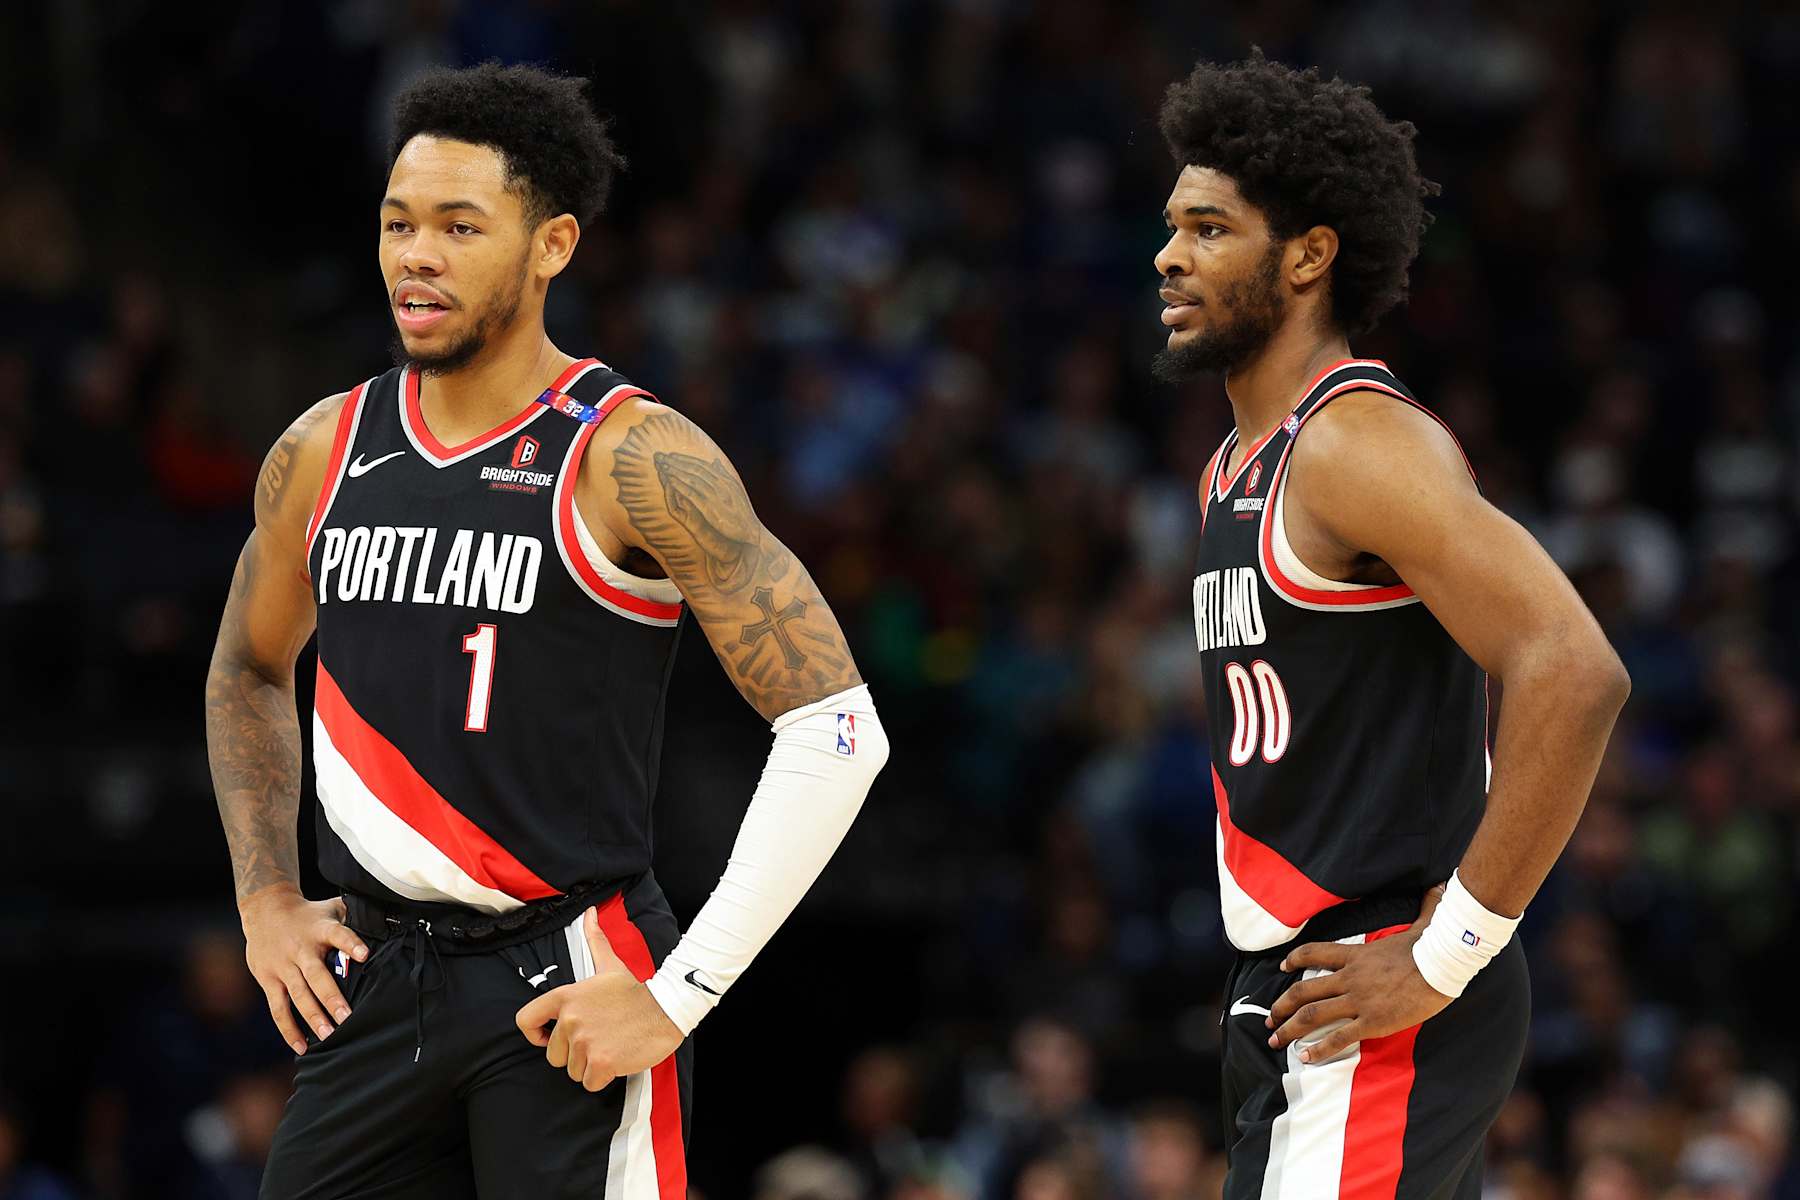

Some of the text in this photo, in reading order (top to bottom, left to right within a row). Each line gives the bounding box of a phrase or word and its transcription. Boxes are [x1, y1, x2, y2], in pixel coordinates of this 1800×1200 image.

[562, 400, 584, 417] 32
[480, 466, 555, 487] BRIGHTSIDE
[520, 441, 535, 463] B
[489, 483, 538, 494] WINDOWS
[319, 526, 543, 614] PORTLAND
[1193, 567, 1267, 652] ORTLAND
[462, 623, 497, 732] 1
[1225, 659, 1292, 767] 00
